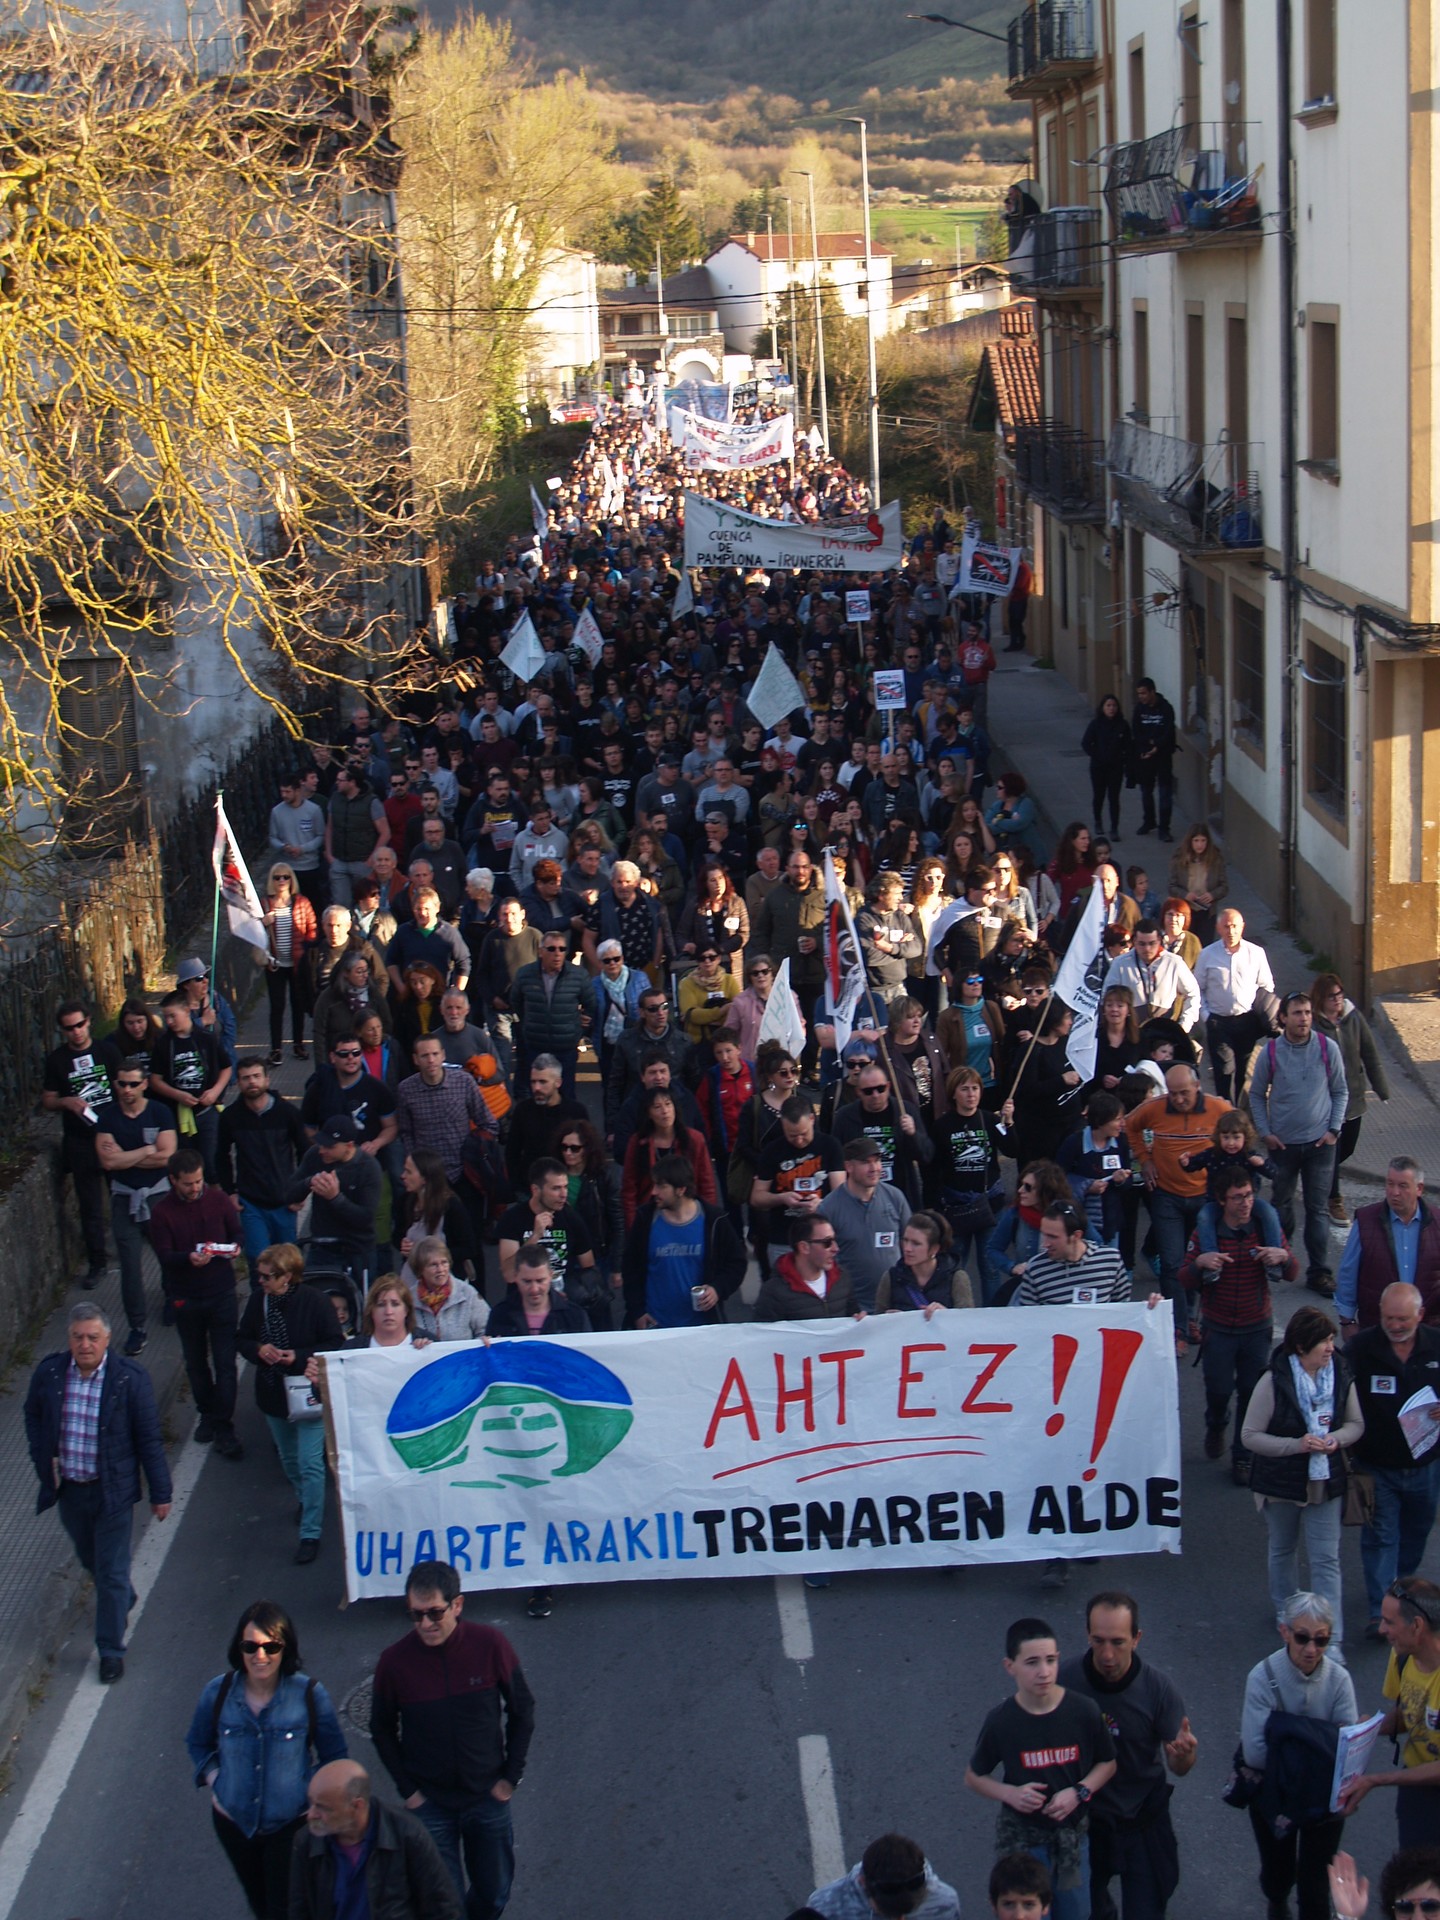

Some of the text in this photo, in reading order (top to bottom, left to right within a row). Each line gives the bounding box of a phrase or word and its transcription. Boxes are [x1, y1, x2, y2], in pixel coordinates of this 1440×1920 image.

[708, 530, 753, 543] CUENCA
[717, 542, 733, 553] DE
[696, 552, 763, 566] PAMPLONA
[524, 844, 557, 858] FILA
[704, 1350, 865, 1449] AHT
[898, 1343, 1017, 1418] EZ
[356, 1477, 1181, 1577] UHARTE ARAKIL TRENAREN ALDE
